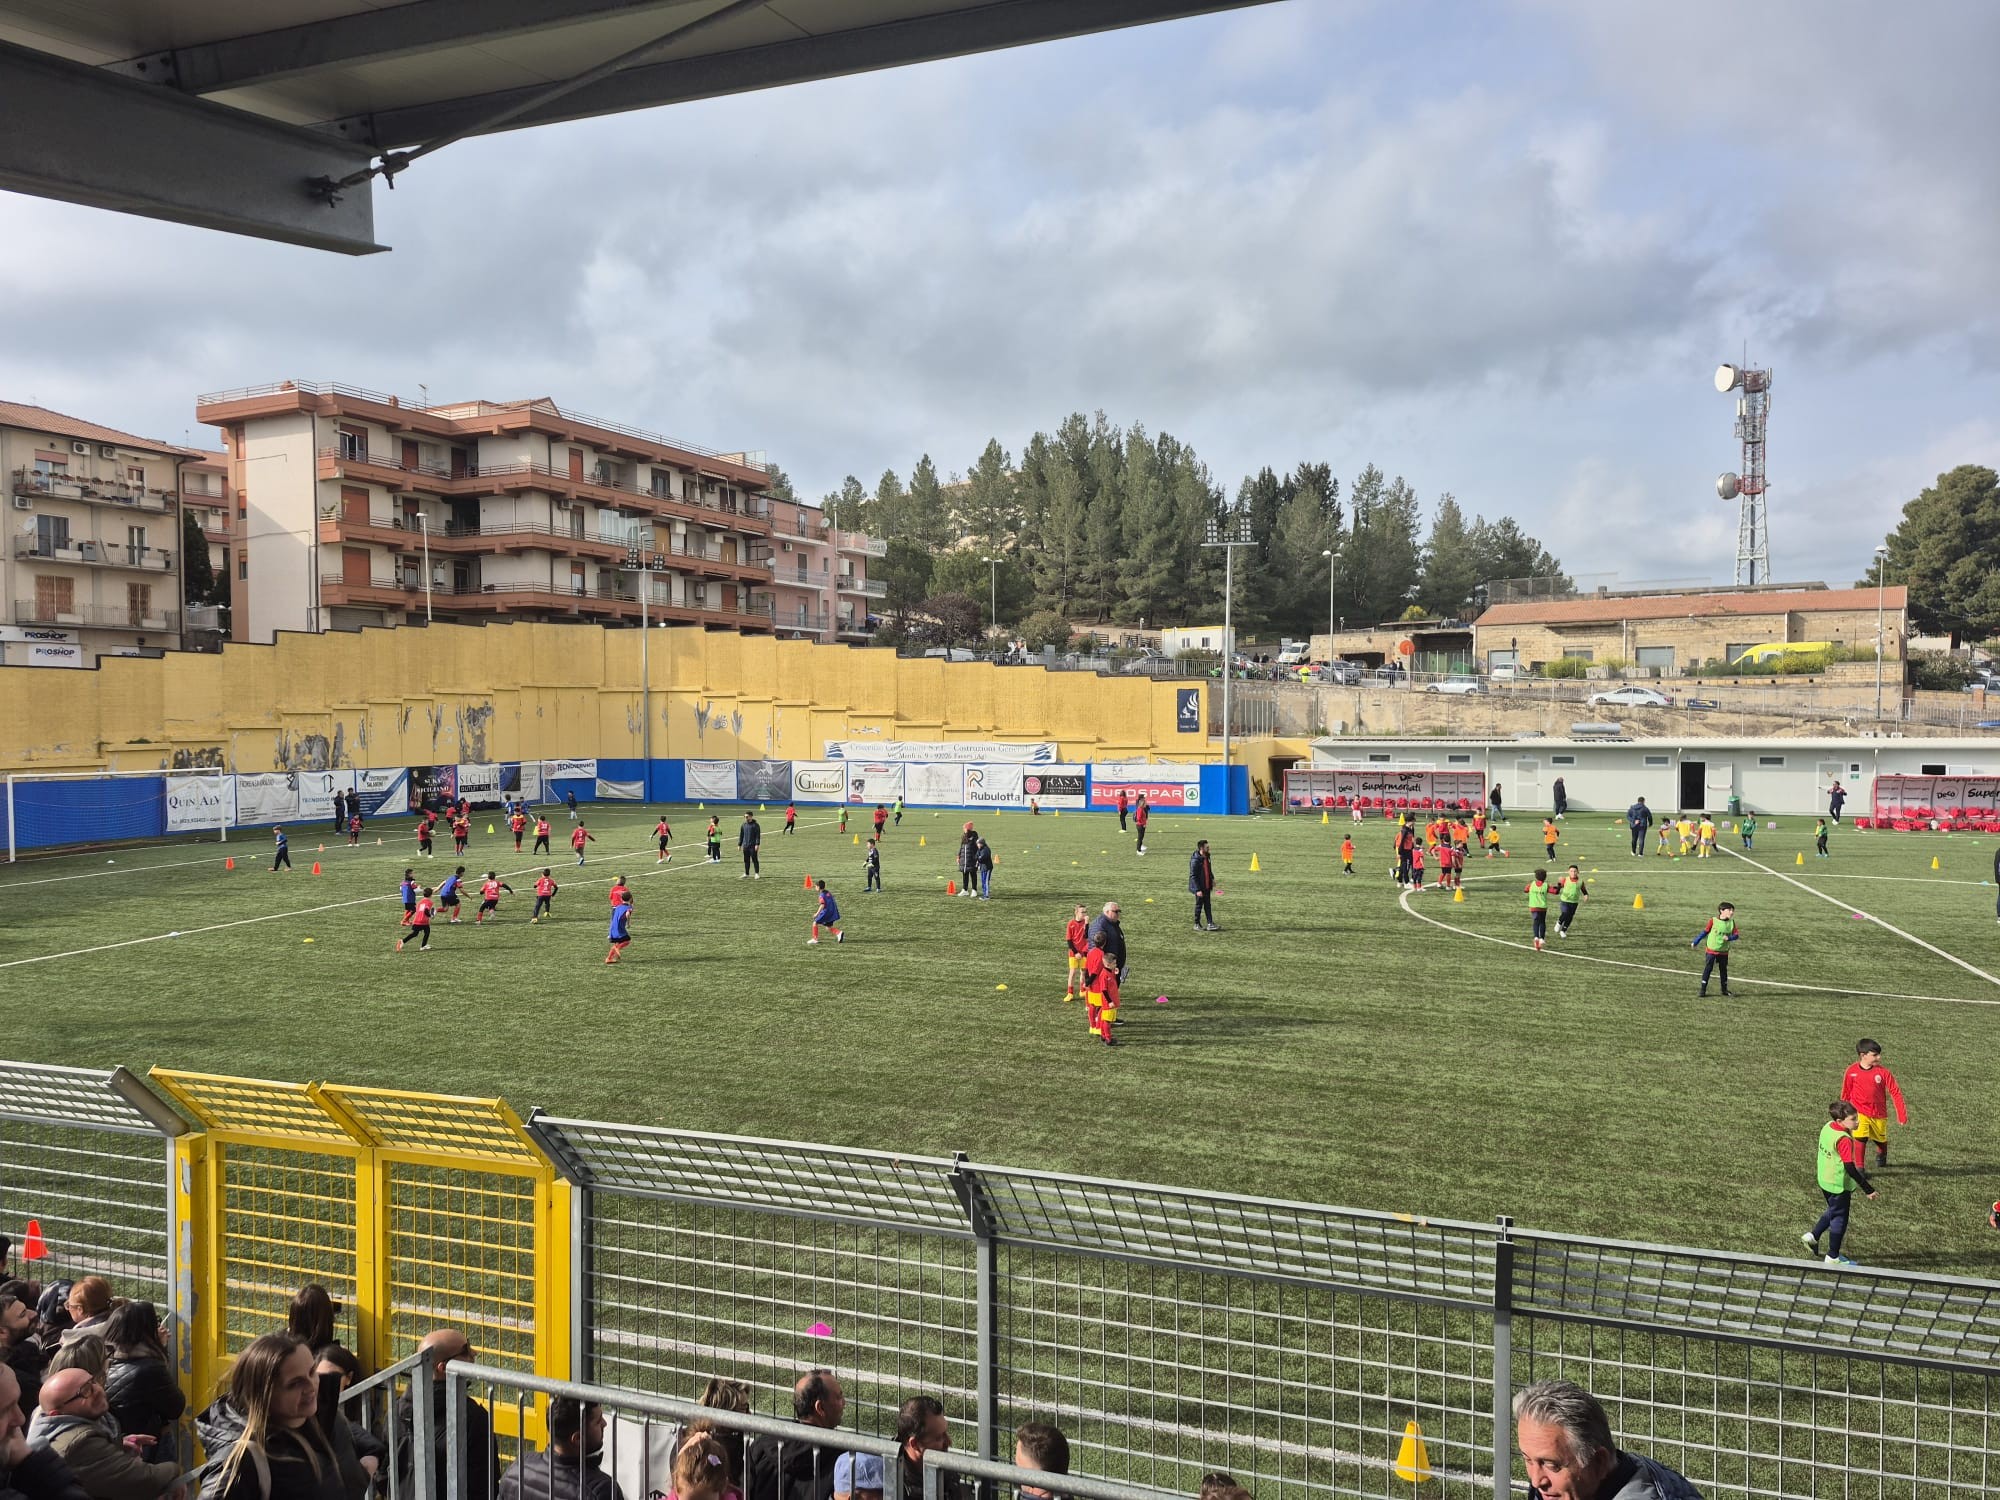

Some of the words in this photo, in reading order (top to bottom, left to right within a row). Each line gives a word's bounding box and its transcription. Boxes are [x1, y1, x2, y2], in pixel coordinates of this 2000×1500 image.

[25, 631, 68, 640] PROSHOP
[36, 647, 75, 656] PROSHOP
[953, 744, 996, 753] Costruzioni
[799, 773, 840, 790] Glorioso
[1050, 777, 1080, 787] CASA
[1362, 782, 1421, 792] Supermercati
[971, 791, 1021, 802] Rubulotta
[1092, 788, 1183, 798] EUROSPAR
